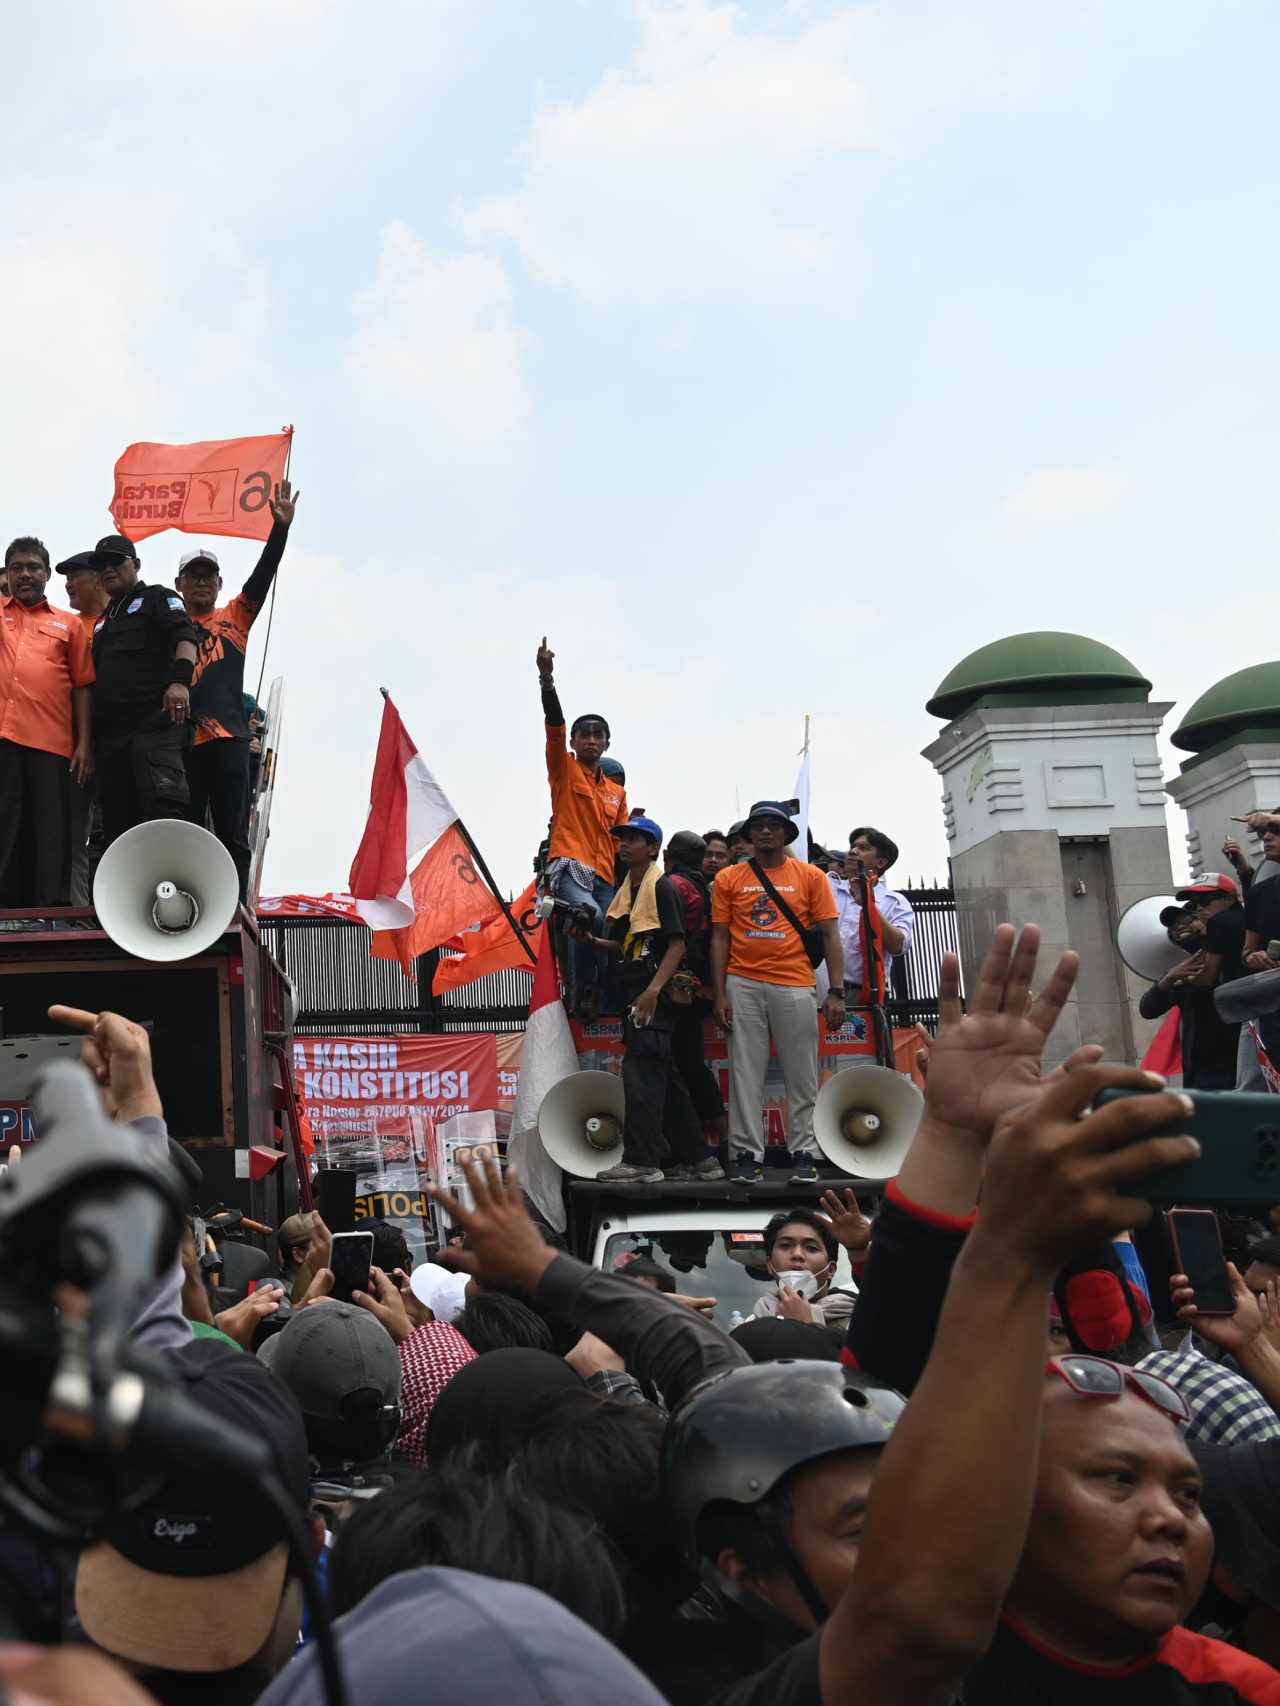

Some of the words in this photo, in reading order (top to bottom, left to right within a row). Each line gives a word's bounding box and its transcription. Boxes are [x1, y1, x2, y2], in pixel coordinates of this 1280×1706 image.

[314, 1043, 398, 1070] KASIH
[304, 1071, 469, 1099] KONSTITUSI
[153, 1518, 198, 1543] Erigo
